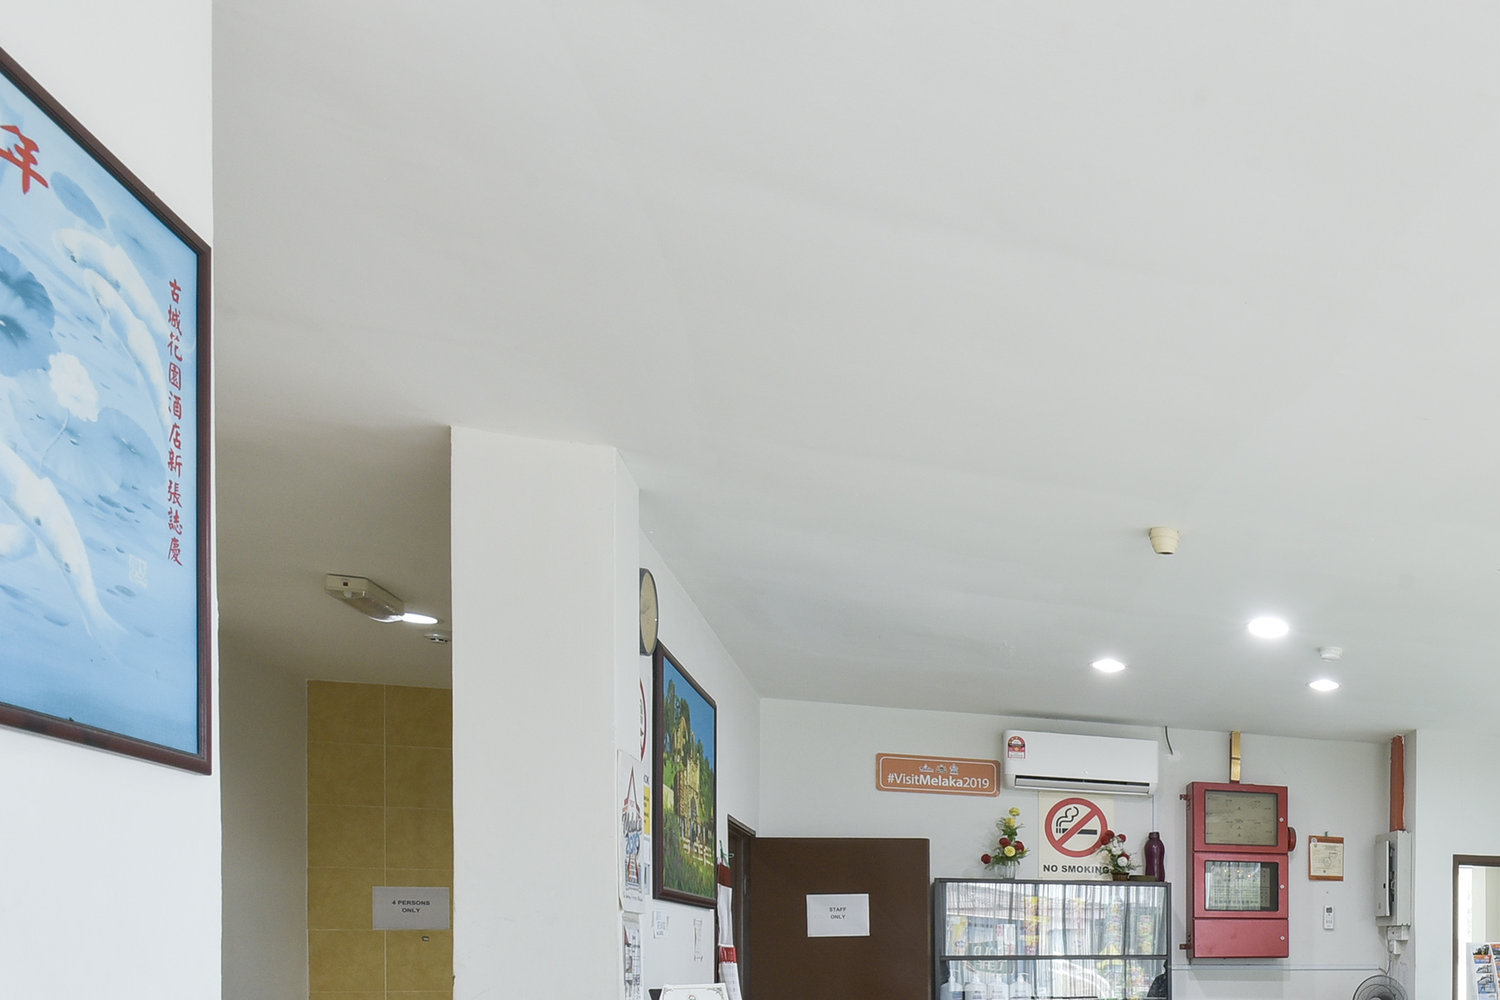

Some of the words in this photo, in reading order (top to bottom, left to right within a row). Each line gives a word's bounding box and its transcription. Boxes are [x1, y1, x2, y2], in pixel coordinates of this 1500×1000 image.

[167, 278, 183, 567] 古城花園酒店新張誌慶
[887, 773, 990, 789] #VisitMelaka2019
[1043, 864, 1058, 873] NO
[1061, 865, 1110, 874] SMOKING
